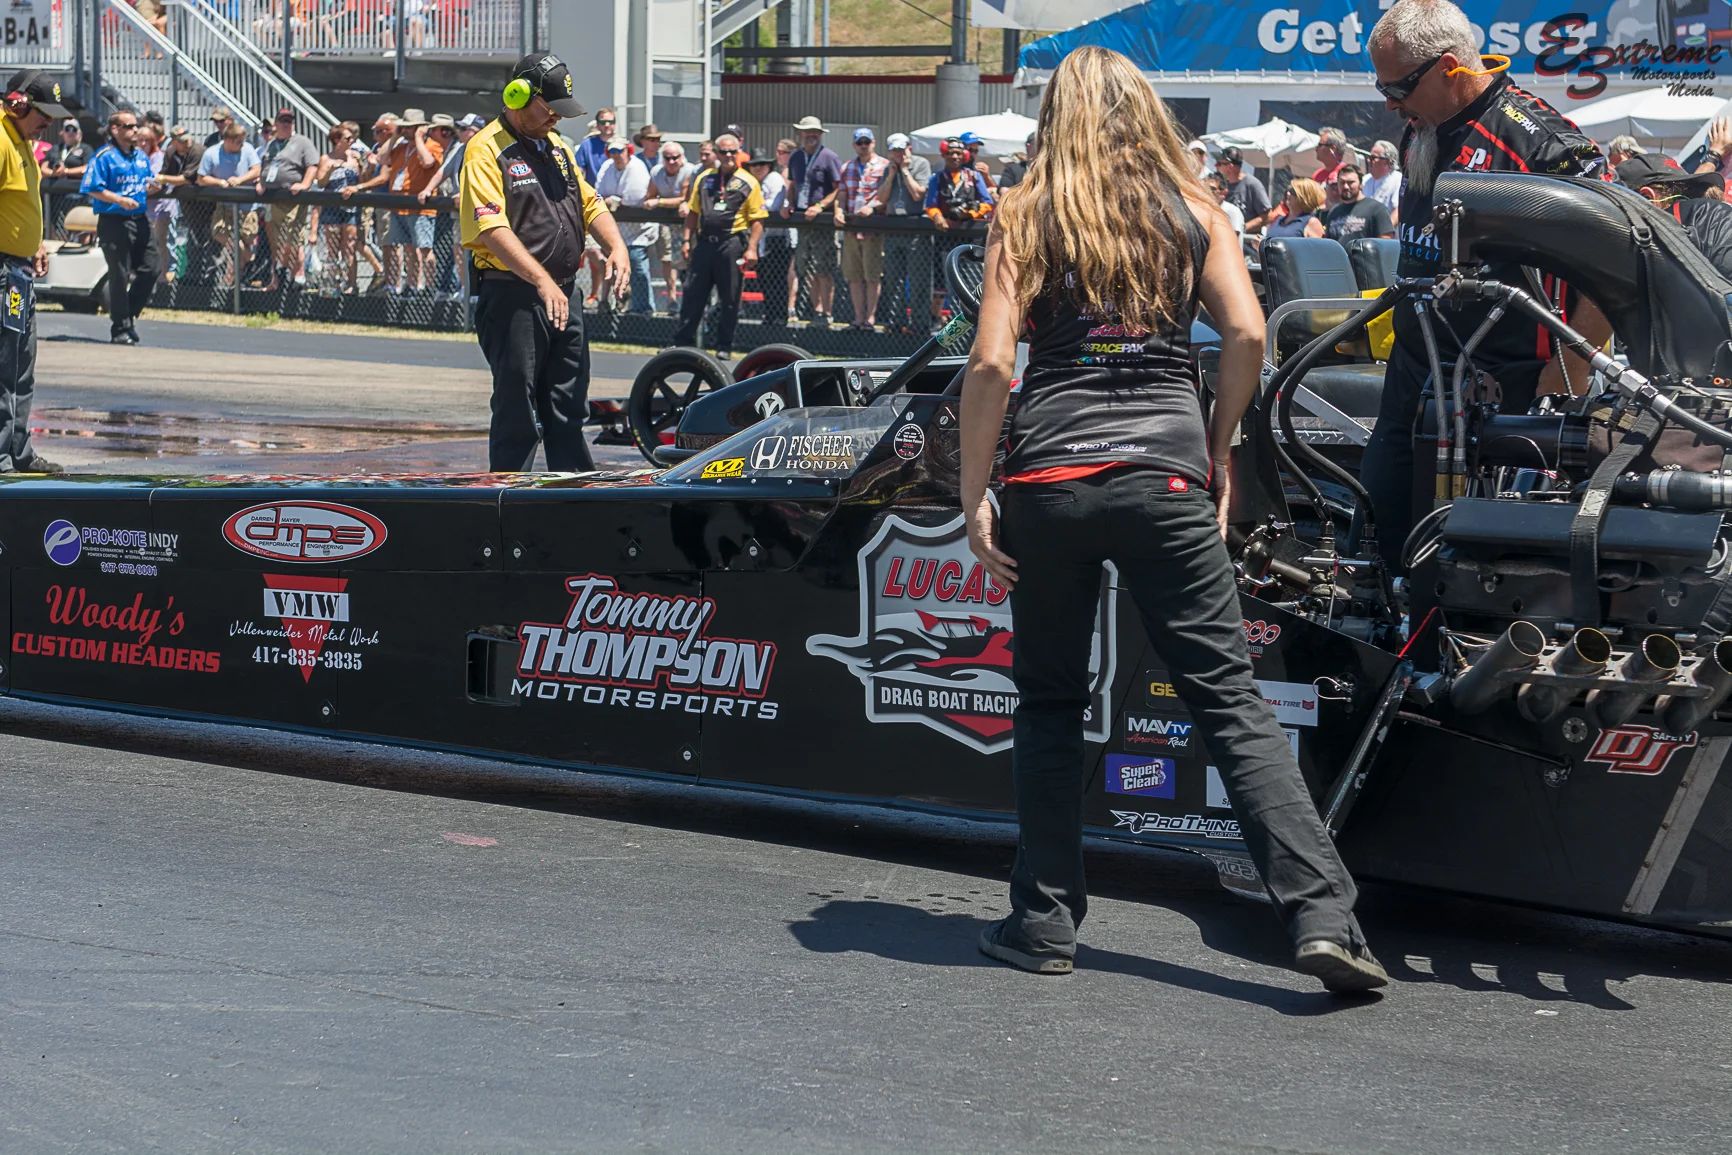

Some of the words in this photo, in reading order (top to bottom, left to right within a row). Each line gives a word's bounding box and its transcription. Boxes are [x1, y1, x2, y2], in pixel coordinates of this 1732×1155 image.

[1258, 8, 1363, 54] Get
[1474, 21, 1598, 56] ser
[1504, 105, 1541, 135] RACEPAK
[1092, 343, 1146, 353] RACEPAK
[788, 435, 853, 457] FISCHER
[786, 459, 849, 470] HONDA
[81, 526, 148, 548] PRO-KOTE
[148, 532, 179, 549] INDY
[883, 557, 1008, 604] LUCAS
[46, 585, 185, 645] Woody's
[272, 591, 340, 619] VMW
[566, 574, 714, 655] Tommy
[229, 620, 304, 638] Vollenweider
[308, 624, 345, 644] Metal
[349, 627, 380, 646] Work
[12, 632, 107, 661] CUSTOM
[111, 643, 221, 673] HEADERS
[252, 645, 363, 671] 417-835-3835
[519, 624, 773, 691] THOMPSON
[510, 678, 779, 720] MOTORSPORTS
[881, 686, 923, 707] DRAG
[928, 690, 969, 710] BOAT
[973, 693, 1020, 715] RACIN
[1150, 682, 1178, 697] GE
[1283, 700, 1301, 708] TIRE
[1168, 736, 1189, 748] Real
[1121, 764, 1160, 779] Super
[1123, 775, 1159, 790] Clean
[1142, 813, 1240, 832] PROTHING
